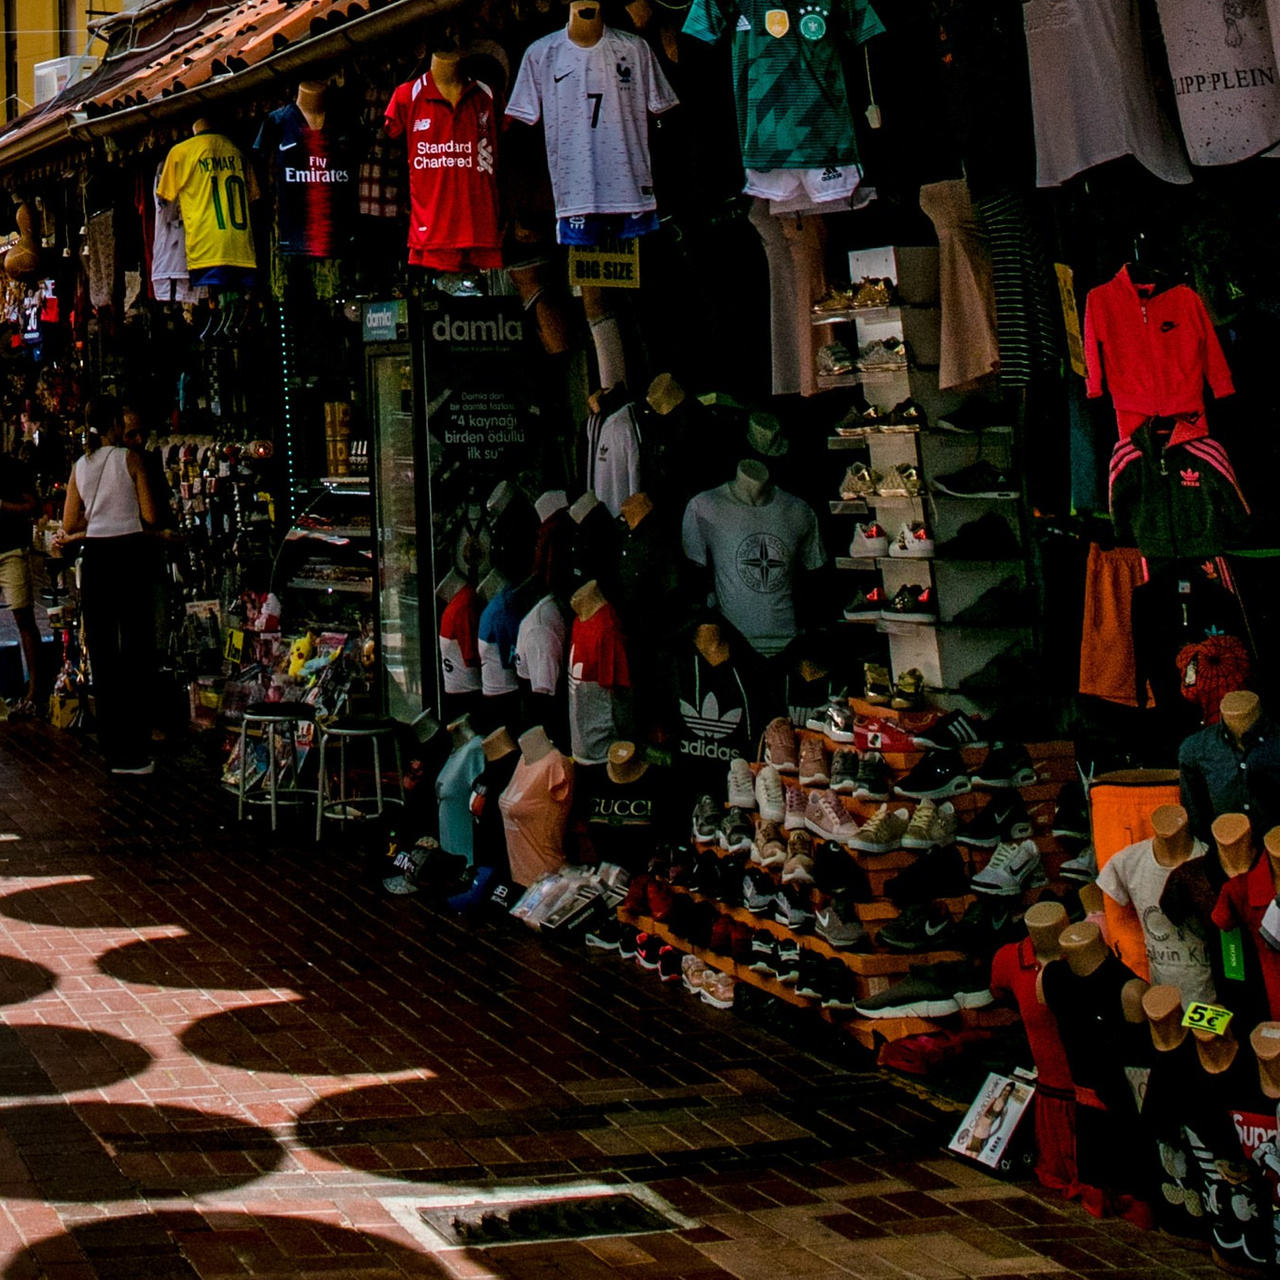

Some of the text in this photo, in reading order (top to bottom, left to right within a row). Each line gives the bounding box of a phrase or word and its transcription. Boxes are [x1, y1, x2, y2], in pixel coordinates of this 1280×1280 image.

[1211, 67, 1274, 90] PLEIN
[587, 93, 603, 129] 7
[417, 140, 472, 155] Standard
[309, 155, 327, 168] Fly
[413, 155, 472, 170] Chartered
[285, 167, 349, 183] Emirates
[211, 175, 247, 230] 10
[576, 260, 633, 280] BIG SIZE
[366, 307, 391, 328] damla
[432, 313, 523, 341] damla
[462, 403, 487, 411] damla
[444, 429, 526, 443] birden ödüllü
[467, 446, 480, 459] ilk
[680, 739, 741, 762] adidas
[591, 797, 652, 816] GUCCI
